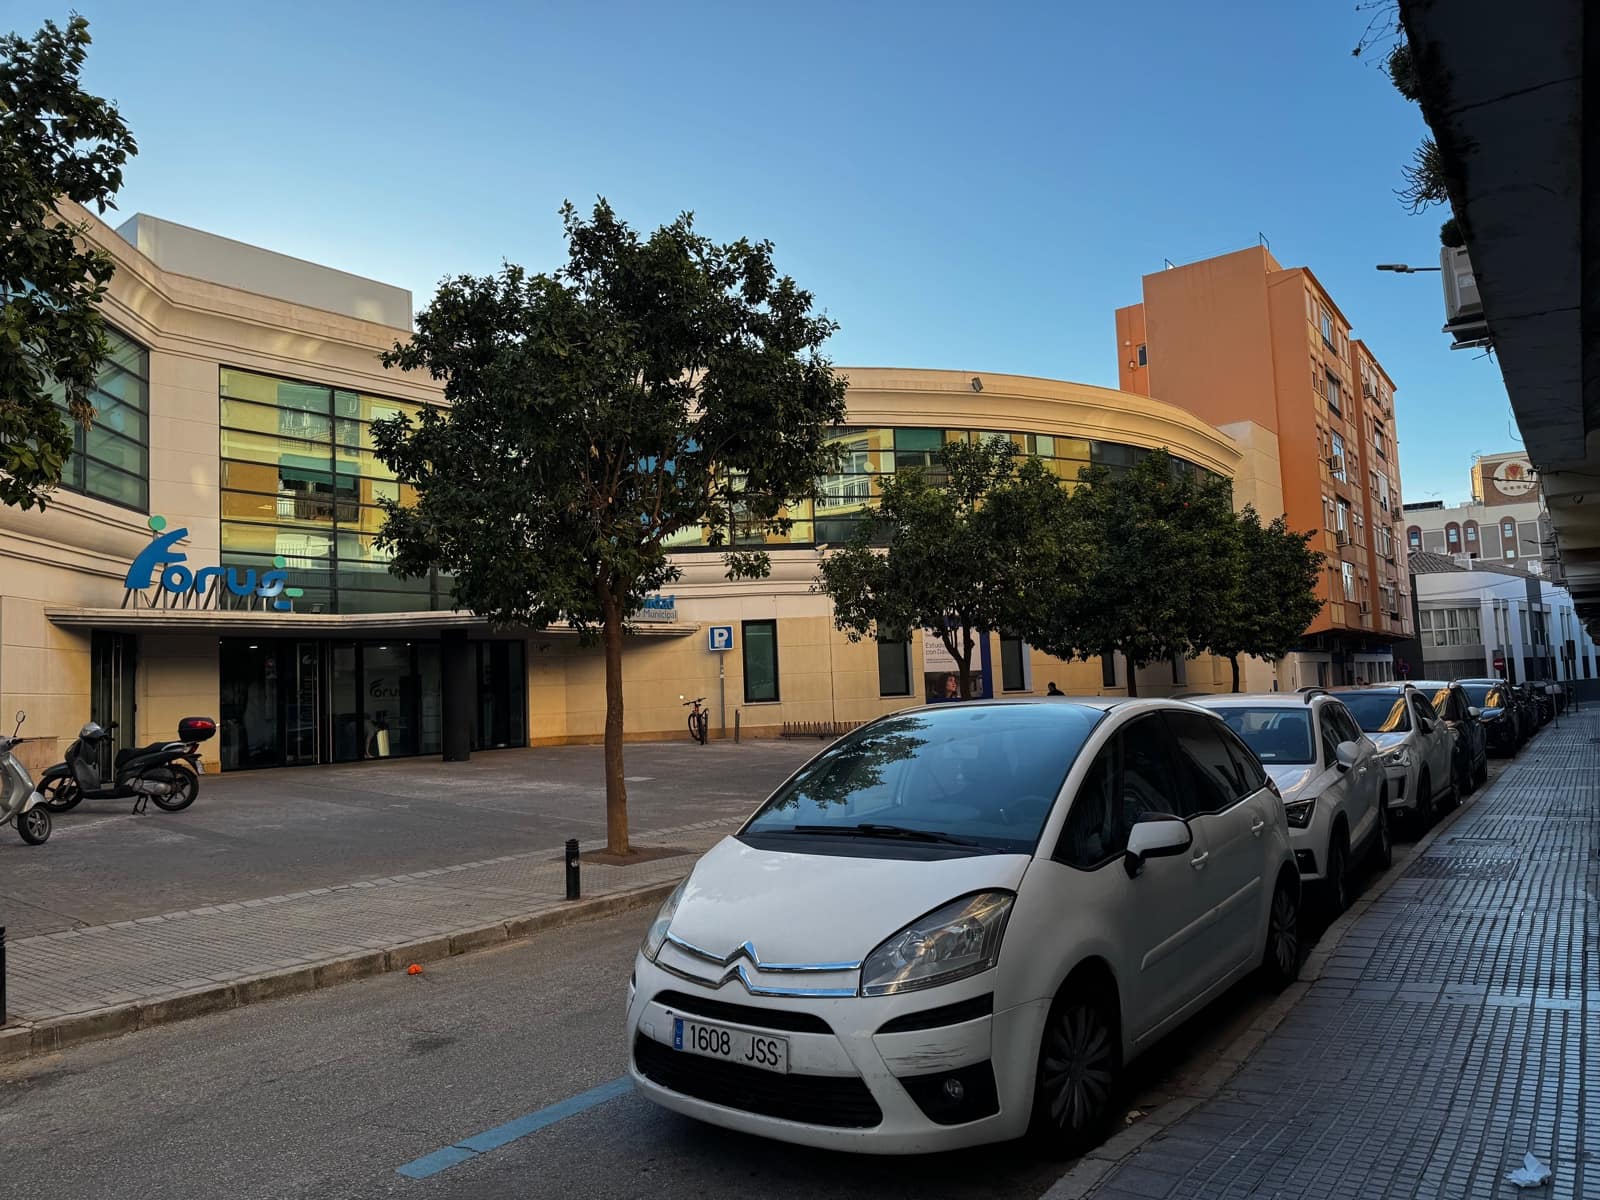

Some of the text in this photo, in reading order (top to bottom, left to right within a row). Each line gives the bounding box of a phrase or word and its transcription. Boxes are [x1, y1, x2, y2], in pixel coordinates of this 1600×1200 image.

[713, 628, 729, 648] P
[690, 1025, 778, 1066] 1608 JSS
